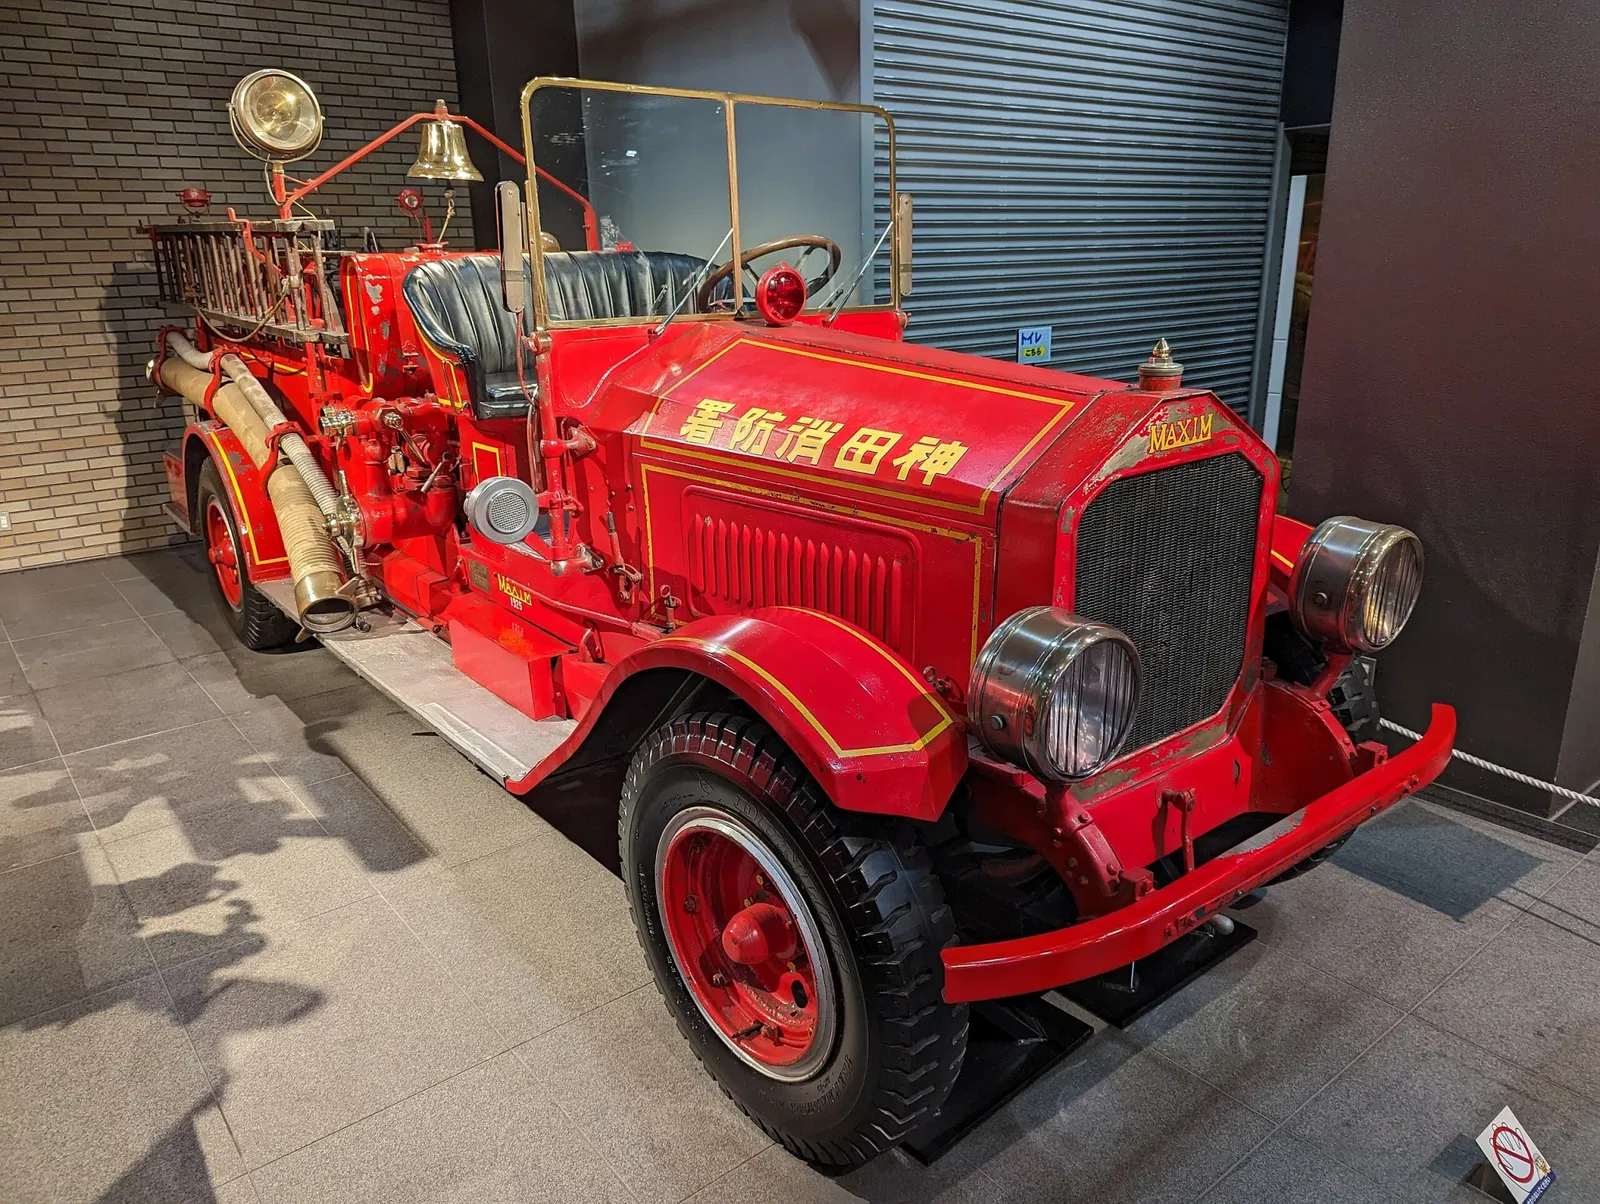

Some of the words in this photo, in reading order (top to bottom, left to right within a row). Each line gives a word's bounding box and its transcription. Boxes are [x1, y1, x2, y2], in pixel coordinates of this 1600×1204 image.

[1025, 347, 1042, 357] こちら
[1149, 412, 1214, 454] MAXIM
[510, 597, 523, 611] 1925
